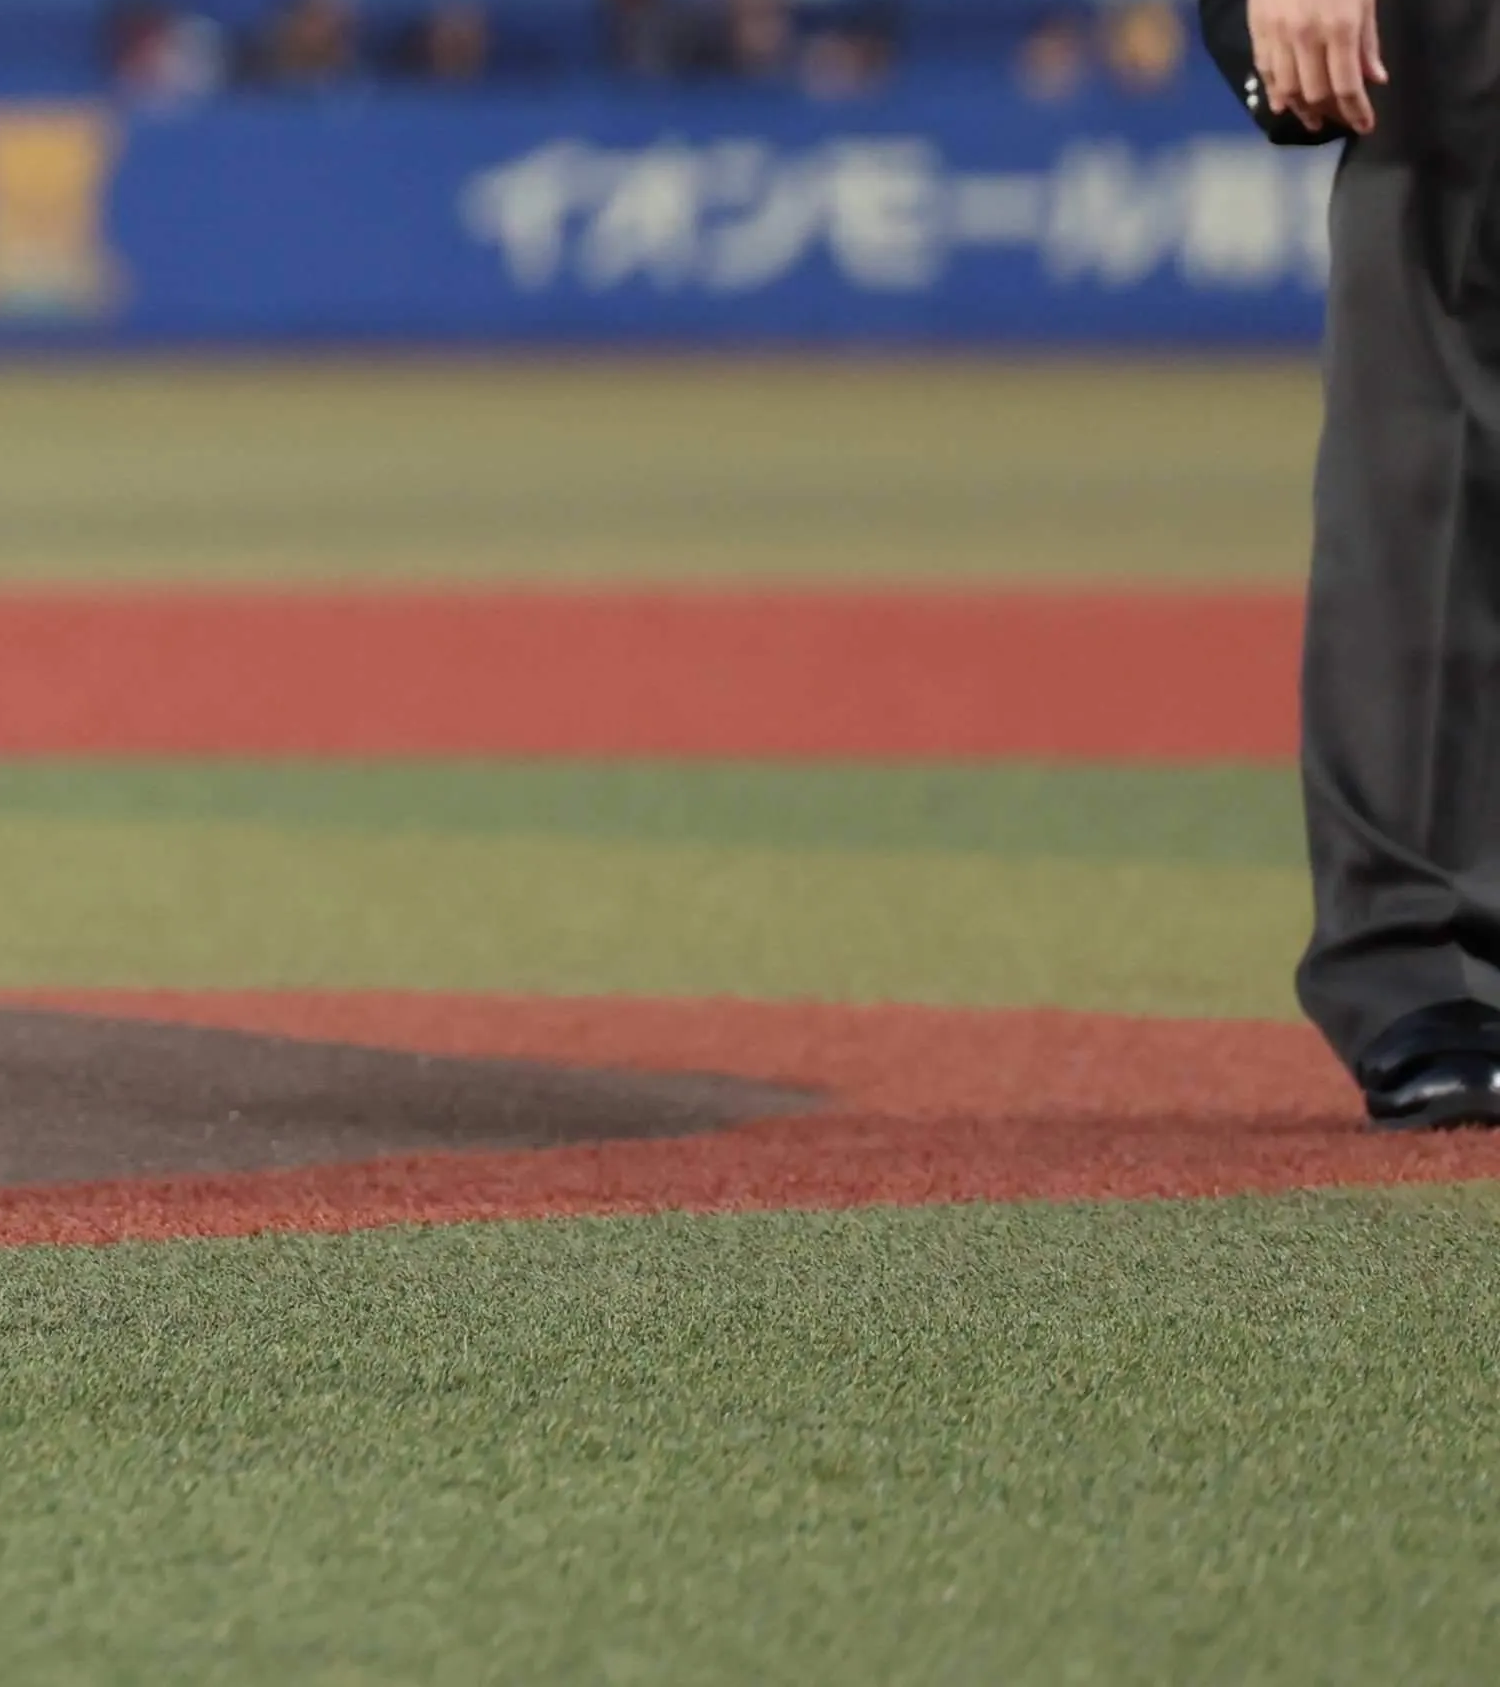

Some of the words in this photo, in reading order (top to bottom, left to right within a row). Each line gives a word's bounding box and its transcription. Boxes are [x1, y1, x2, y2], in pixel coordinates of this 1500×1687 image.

[462, 134, 1332, 292] イオンモール
